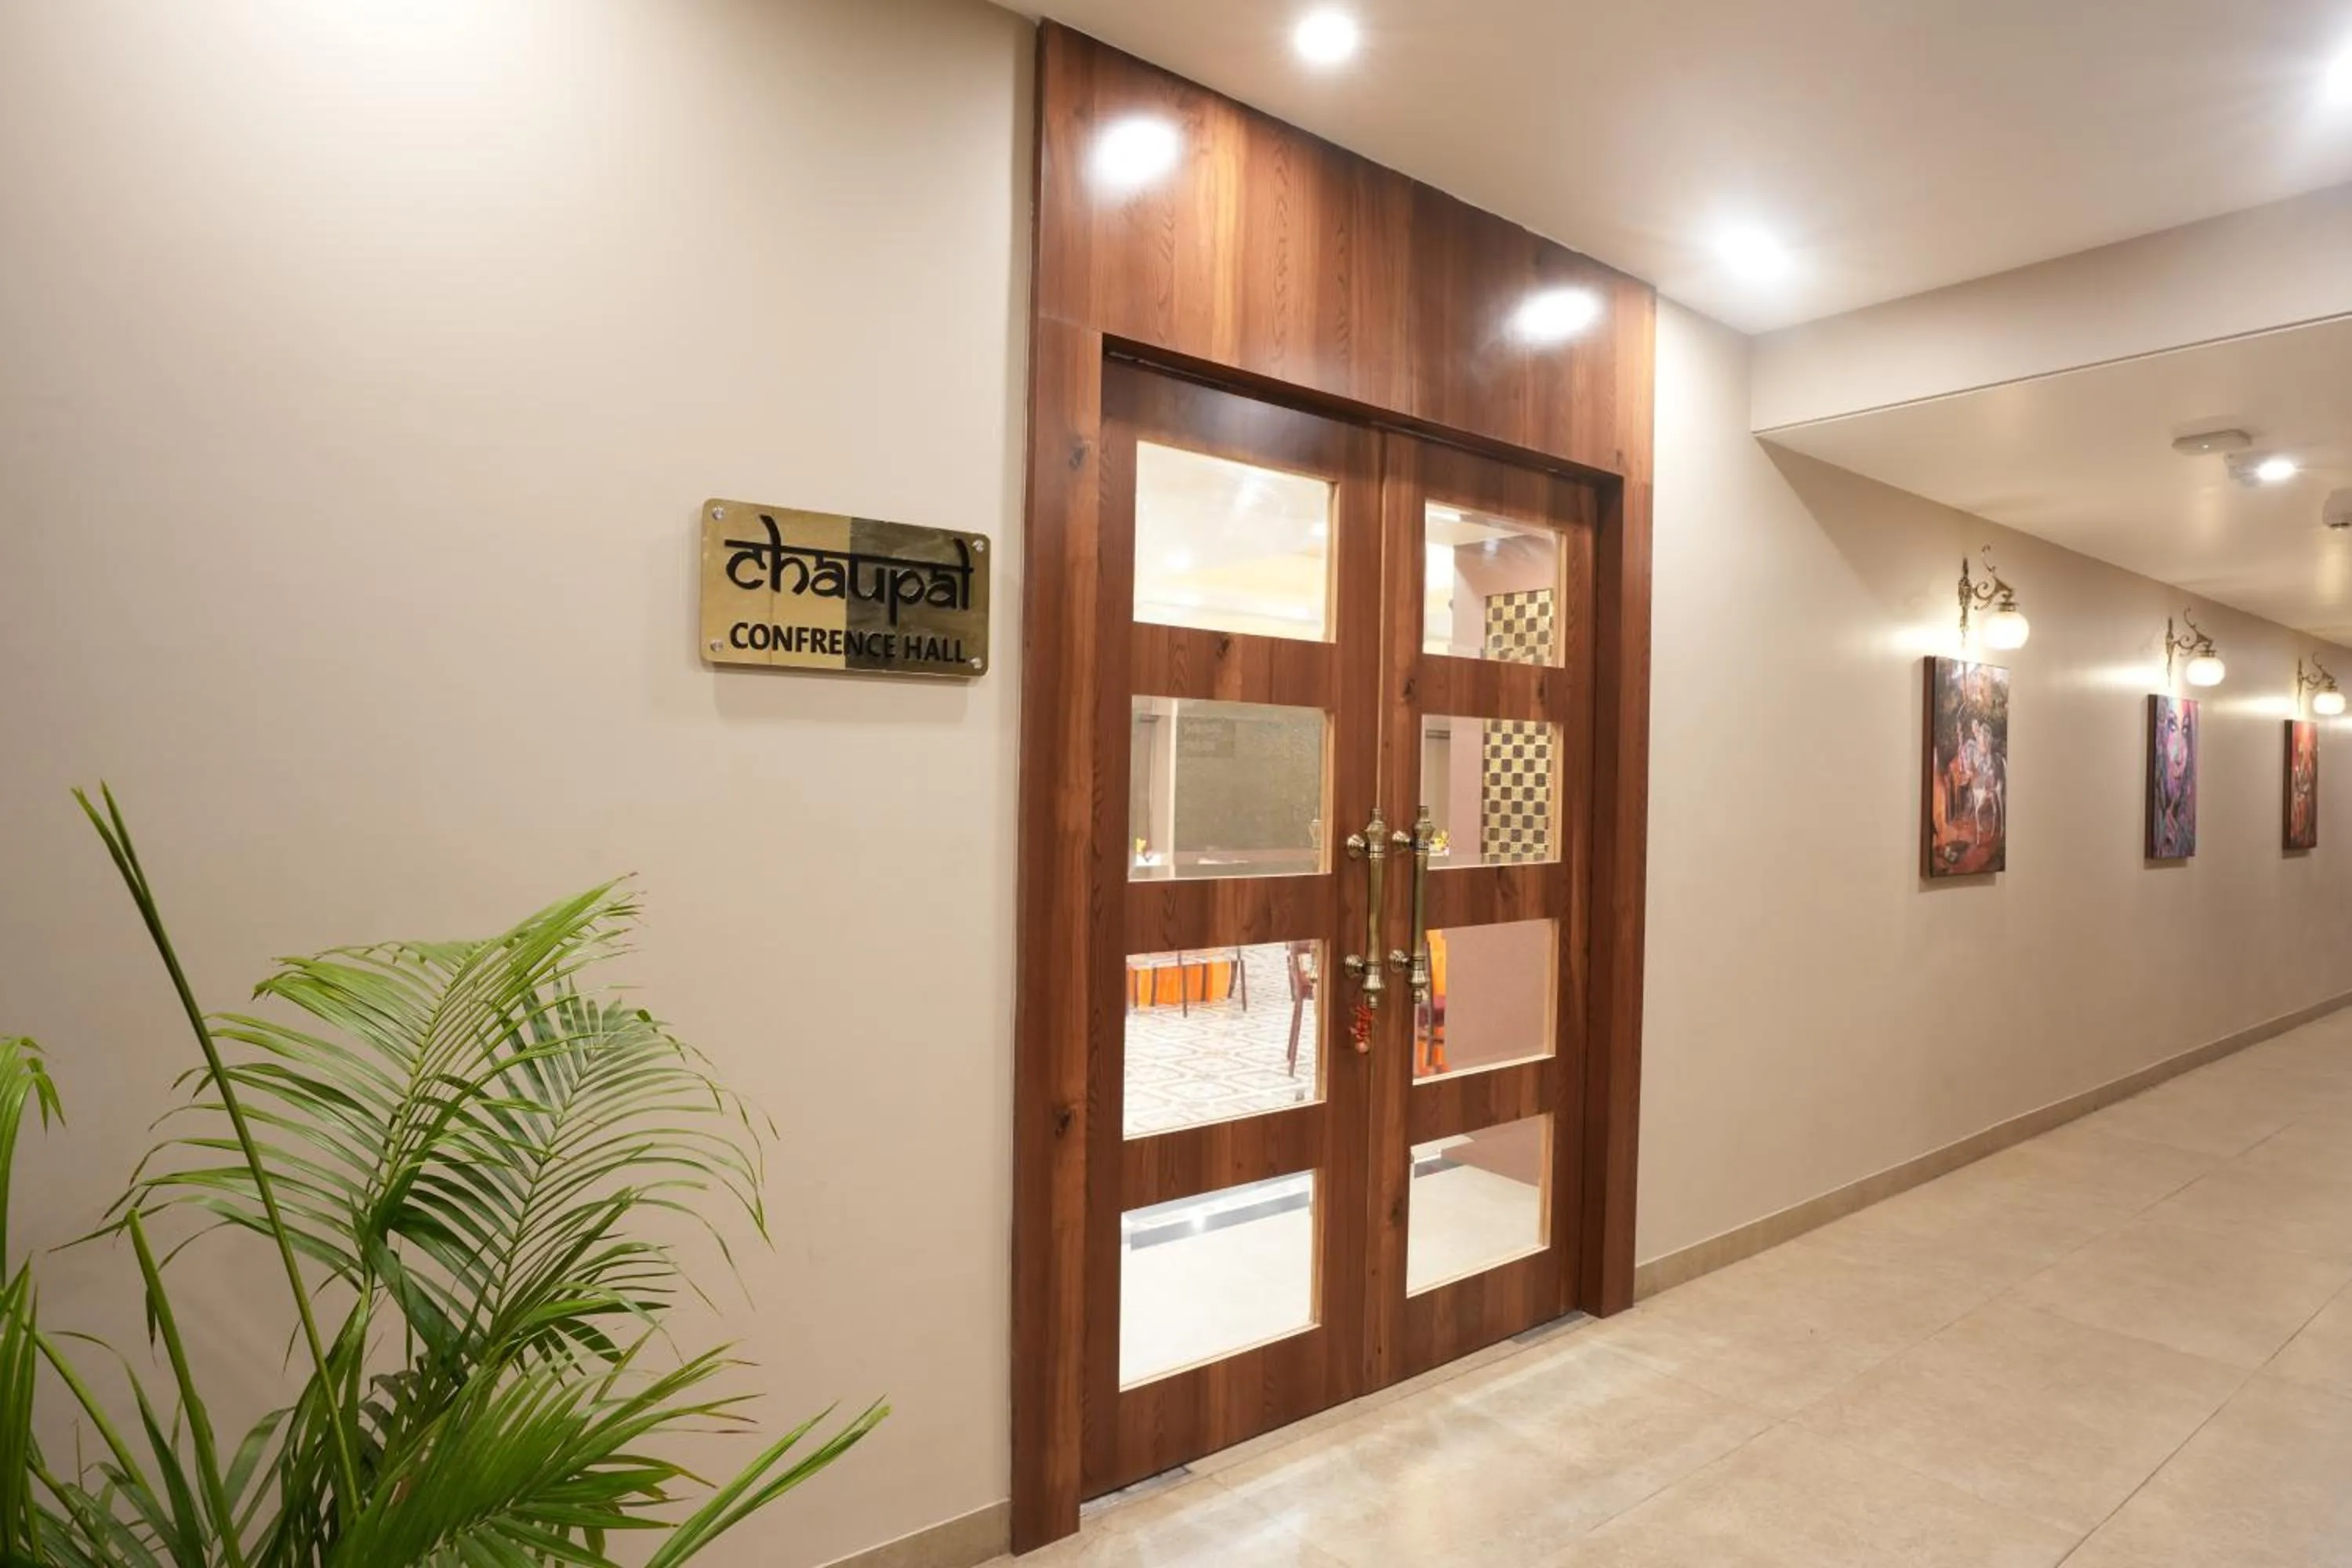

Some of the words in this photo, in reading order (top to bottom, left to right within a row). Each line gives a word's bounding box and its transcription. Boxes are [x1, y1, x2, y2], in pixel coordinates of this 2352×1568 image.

[724, 514, 974, 626] chaupal
[730, 622, 896, 659] CONFRENCE
[904, 637, 967, 664] HALL
